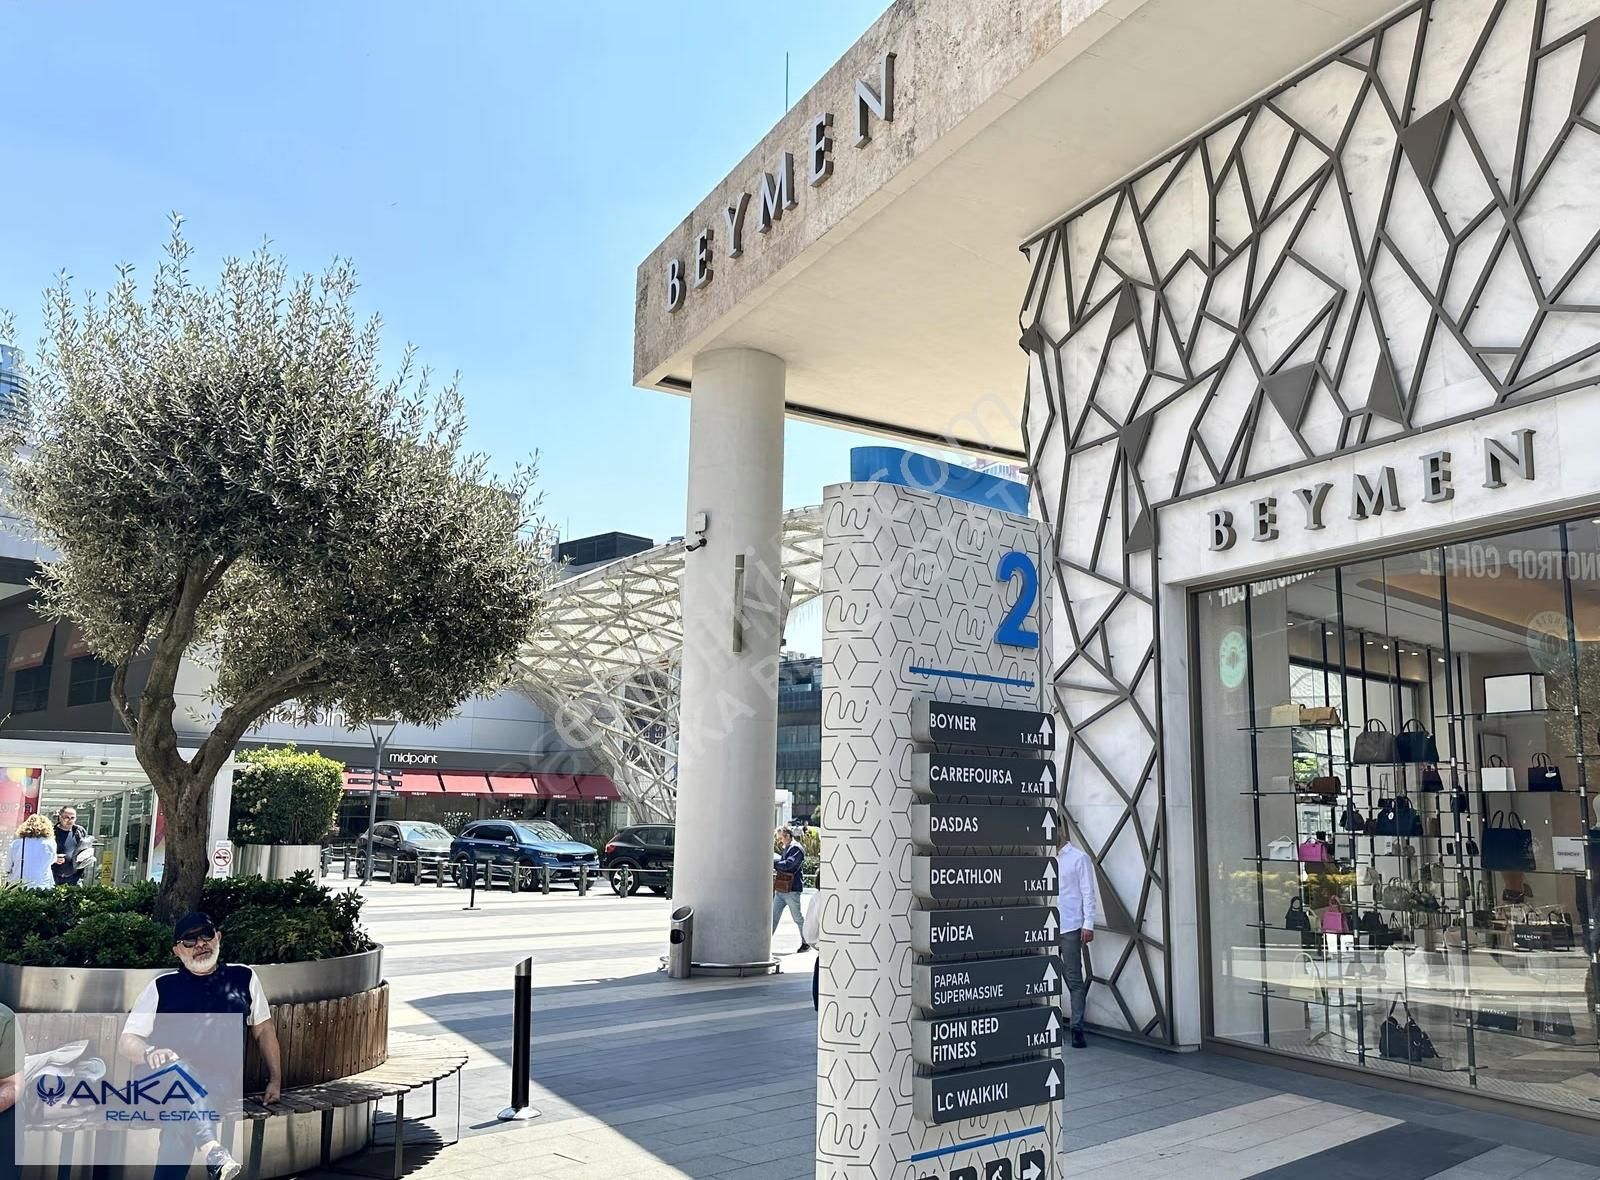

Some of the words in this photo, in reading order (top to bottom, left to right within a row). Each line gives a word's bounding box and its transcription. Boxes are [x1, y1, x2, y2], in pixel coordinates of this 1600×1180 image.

[665, 52, 897, 314] BEYMEN
[1207, 428, 1537, 552] BEYMEN
[994, 551, 1040, 649] 2
[930, 712, 977, 732] BOYNER
[1020, 732, 1043, 745] 1.KAT
[389, 752, 438, 765] midpoint
[930, 765, 1013, 785] CARREFOURSA
[1021, 781, 1043, 794] Z.KAT
[931, 816, 979, 832] DASDAS
[931, 868, 1002, 885] DECATHLON
[1023, 879, 1047, 892] 1.KAT
[931, 922, 974, 943] EVİDEA
[1024, 930, 1048, 942] Z.KAT
[934, 971, 971, 988] PAPARA
[934, 984, 1004, 1005] SUPERMASSIVE
[932, 1020, 967, 1041] JOHN
[971, 1017, 999, 1036] REED
[1026, 1031, 1049, 1047] 1.KAT
[932, 1040, 977, 1063] FITNESS
[937, 1091, 954, 1112] LC
[957, 1082, 1008, 1107] WAIKIKI
